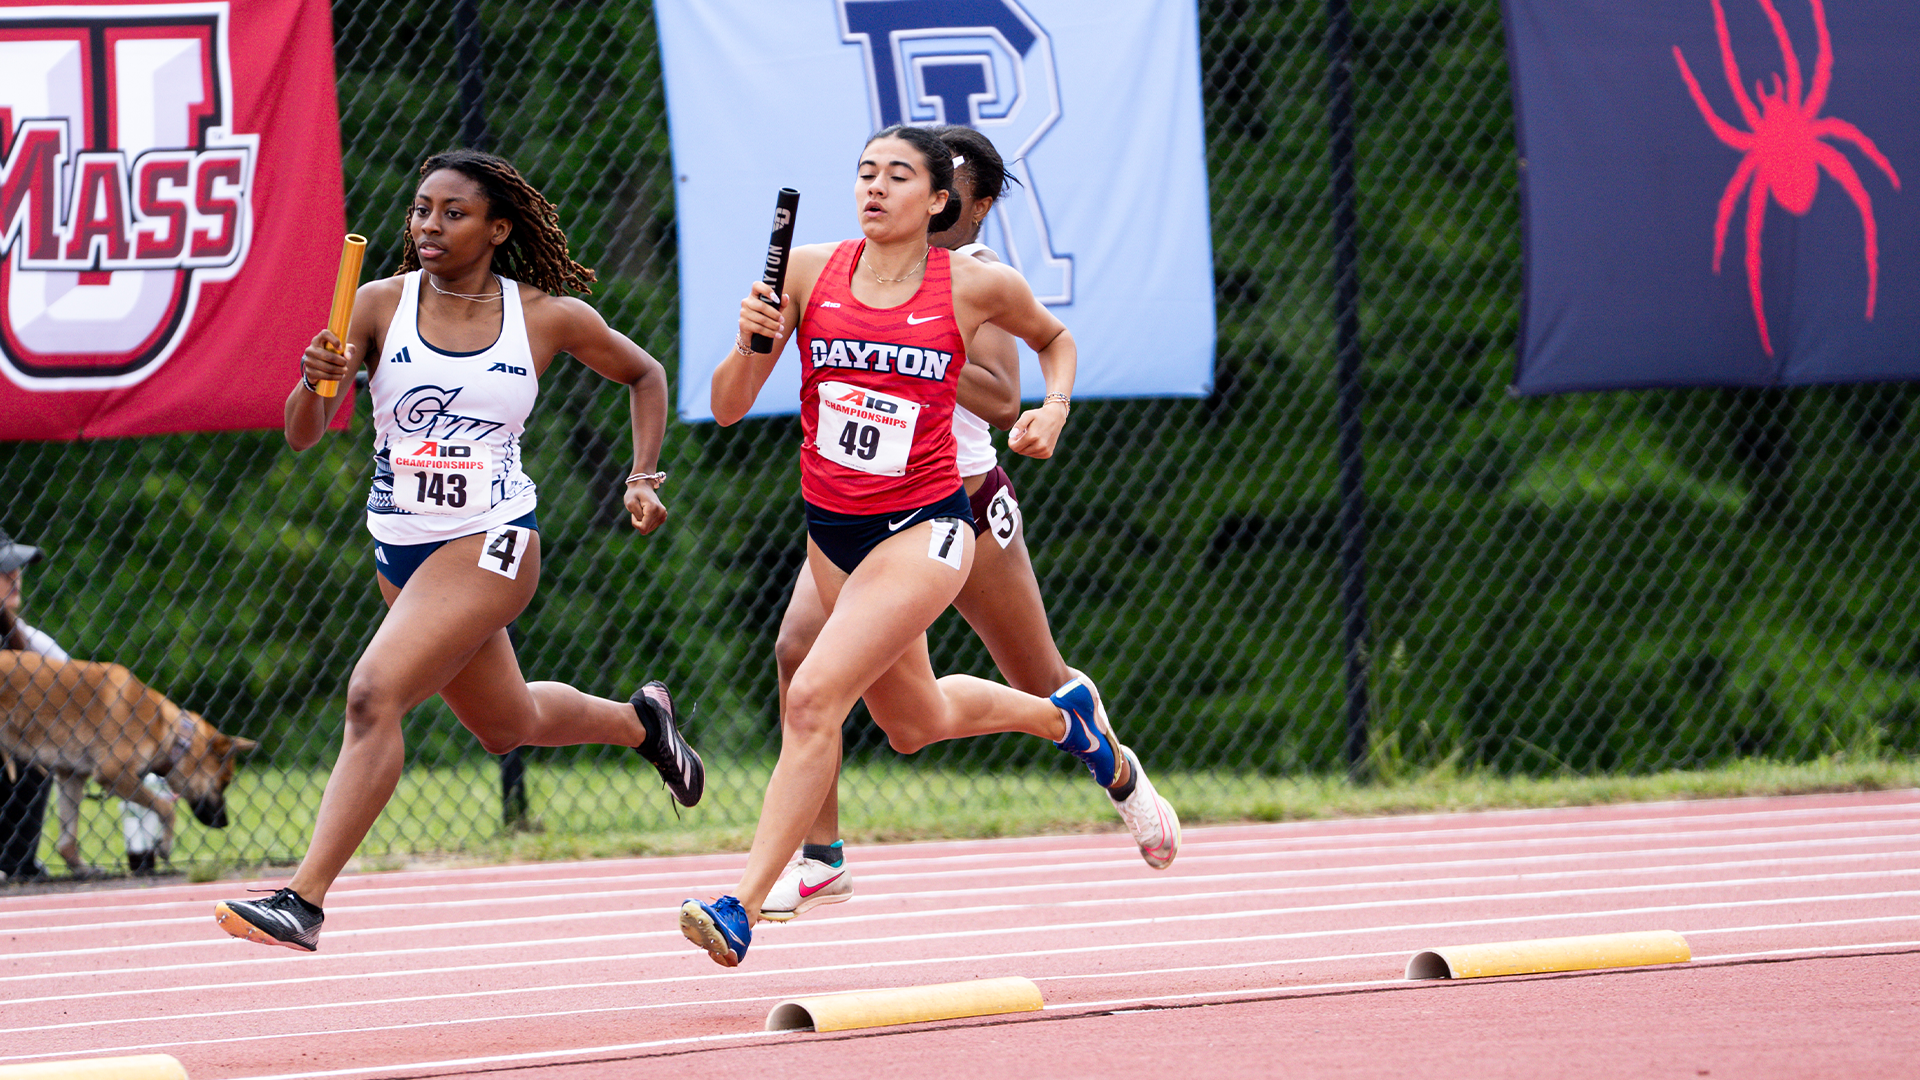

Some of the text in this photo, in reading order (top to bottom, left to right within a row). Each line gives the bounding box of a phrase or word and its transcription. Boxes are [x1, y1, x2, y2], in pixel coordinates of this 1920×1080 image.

[760, 244, 783, 303] YTON
[486, 362, 527, 376] A10
[810, 338, 953, 382] DAYTON
[393, 384, 506, 440] GW
[825, 399, 908, 430] CHAMPIONSHIPS
[836, 388, 898, 415] A10
[411, 441, 471, 458] A10
[838, 420, 881, 461] 49
[395, 457, 484, 470] CHAMPIONSHIPS
[414, 470, 467, 508] 143
[989, 494, 1014, 539] 3
[486, 529, 518, 572] 4
[934, 516, 959, 560] 7
